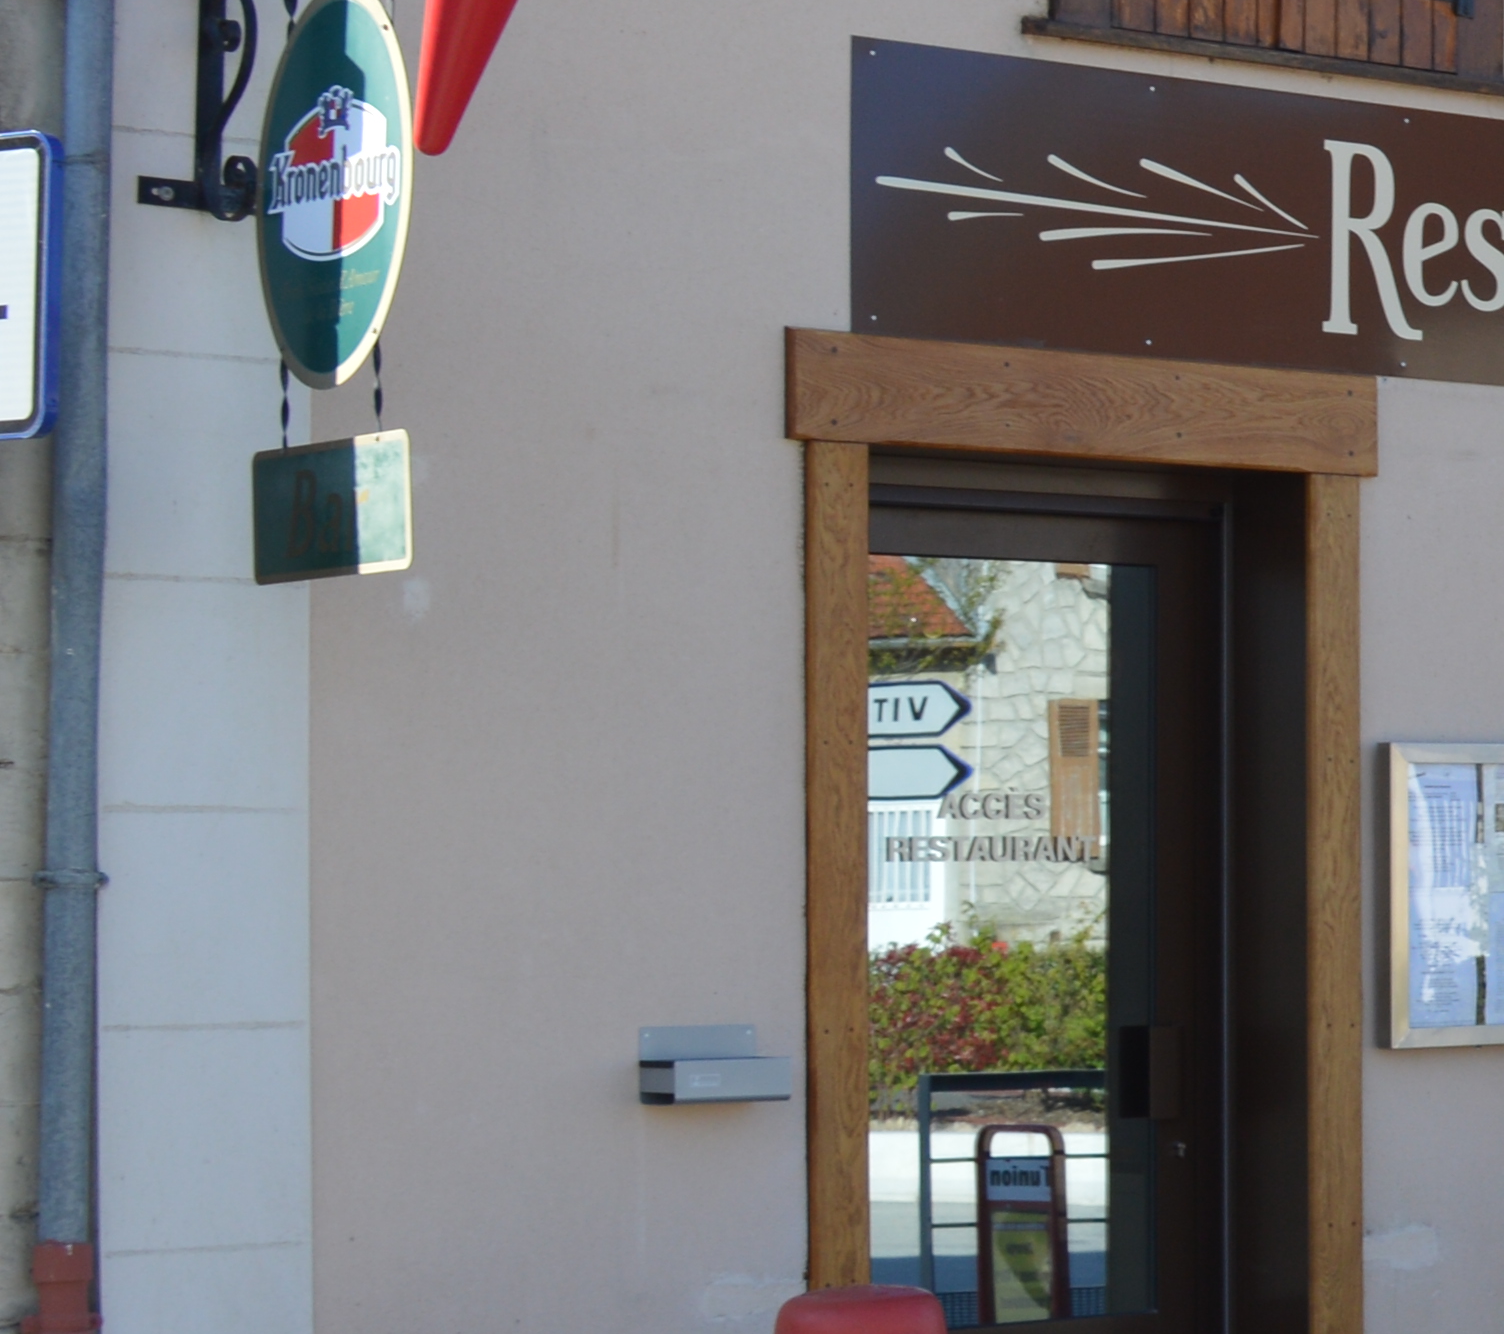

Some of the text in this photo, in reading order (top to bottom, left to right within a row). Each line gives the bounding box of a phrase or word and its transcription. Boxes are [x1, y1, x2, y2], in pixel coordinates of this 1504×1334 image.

[270, 145, 399, 211] Kronenbourg
[937, 787, 1047, 820] ACCÈS
[885, 835, 1098, 864] RESTAURANT
